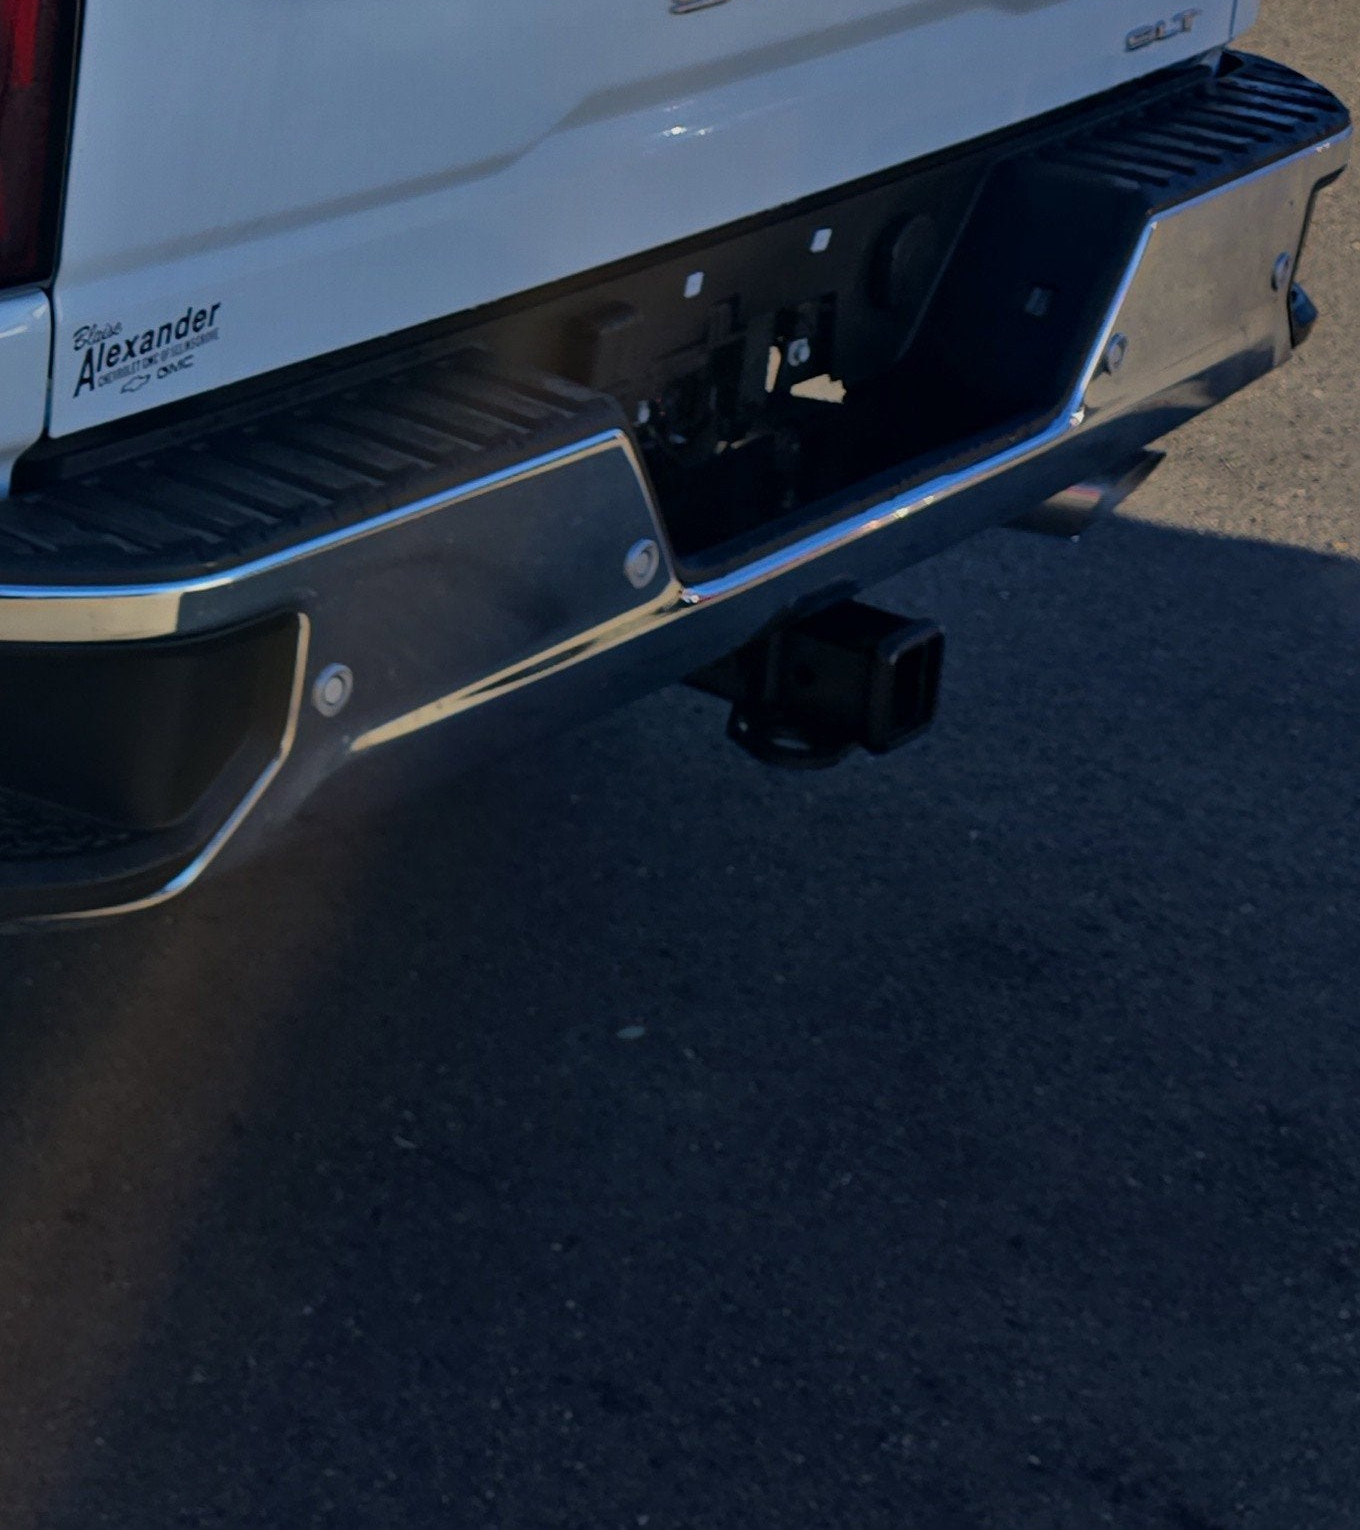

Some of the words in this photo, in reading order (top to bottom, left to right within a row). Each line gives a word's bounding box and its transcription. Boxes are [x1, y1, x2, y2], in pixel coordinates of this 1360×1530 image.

[1125, 7, 1204, 52] SLT
[72, 301, 222, 399] Alexander
[156, 353, 195, 379] GMC
